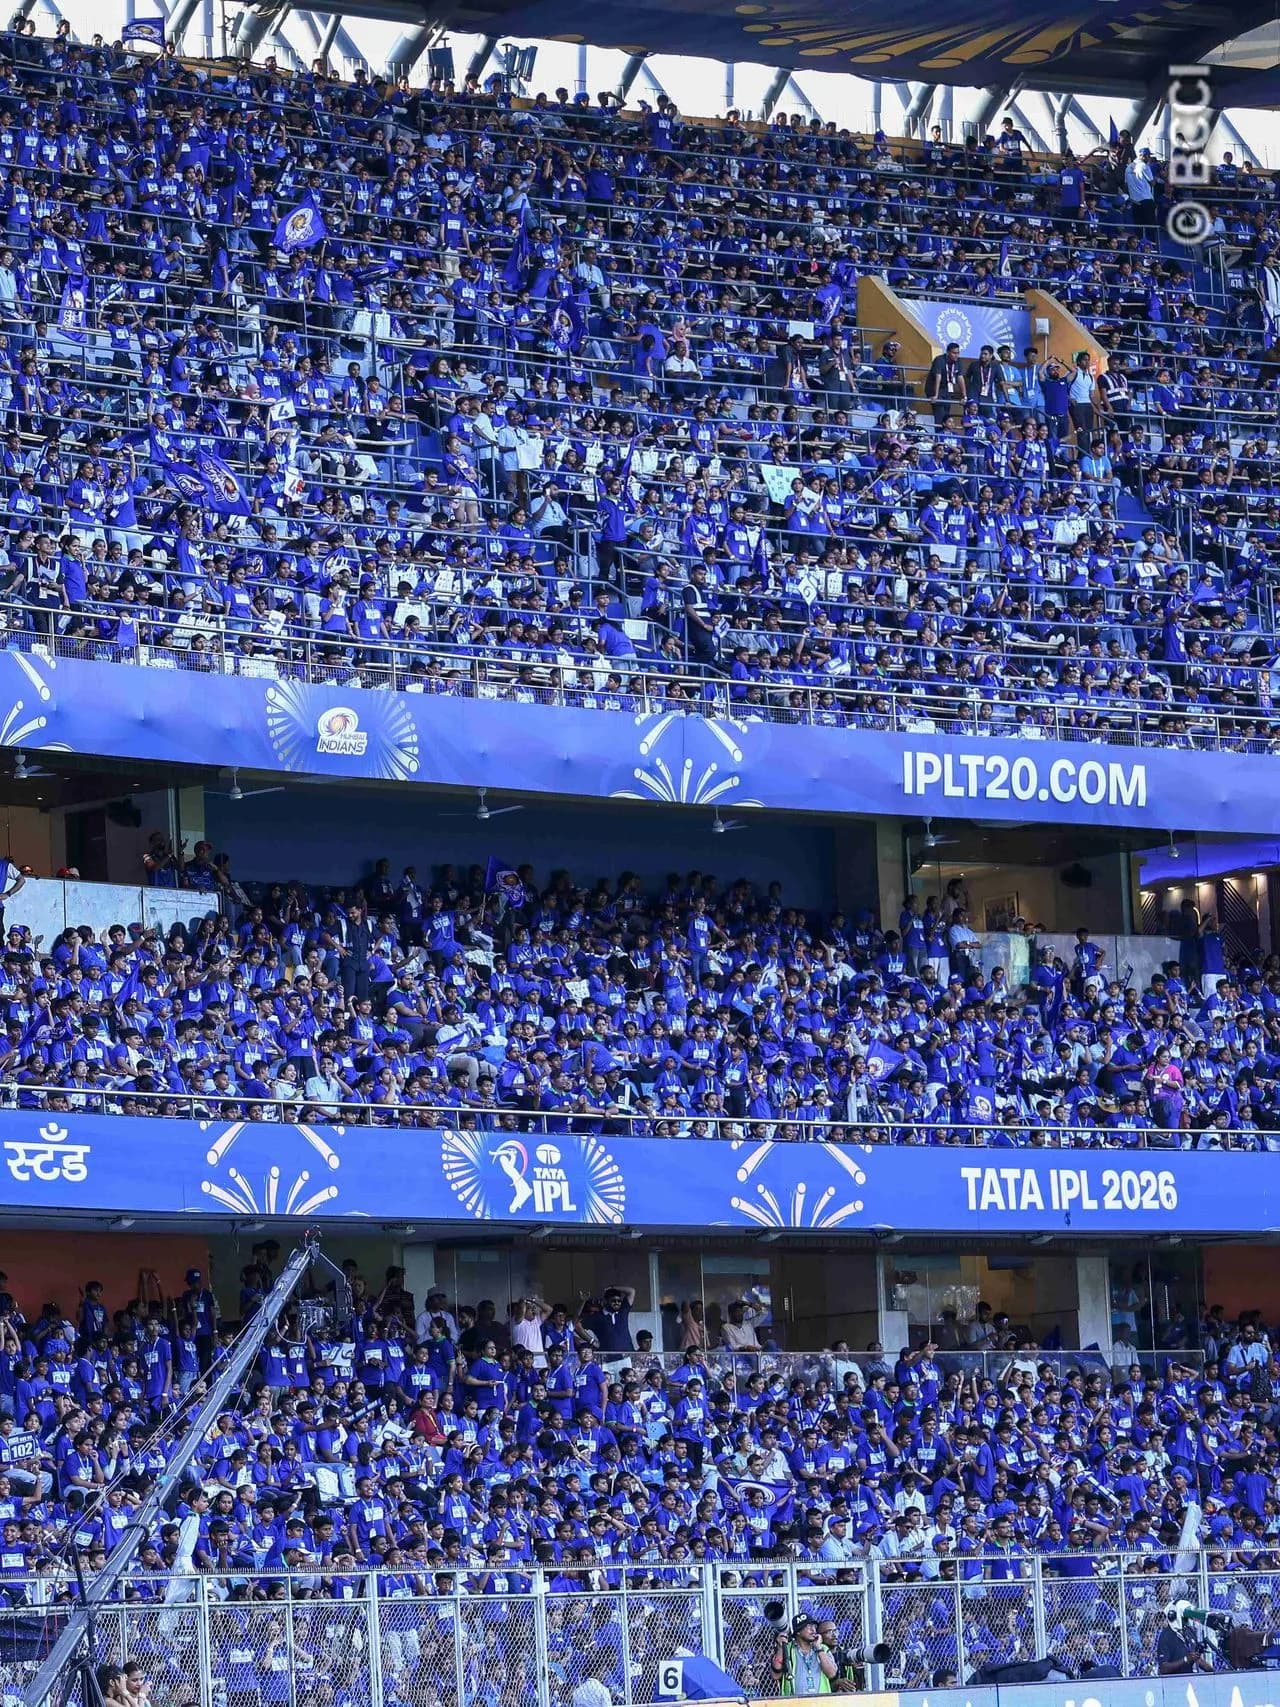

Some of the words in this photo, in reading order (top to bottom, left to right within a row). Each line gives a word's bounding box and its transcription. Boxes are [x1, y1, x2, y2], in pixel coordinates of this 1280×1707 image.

[277, 404, 290, 417] 4
[318, 738, 366, 754] INDIANS
[902, 749, 1148, 808] IPLT20.COM
[3, 1122, 91, 1182] स्टँड
[533, 1167, 567, 1180] TATA
[532, 1180, 577, 1213] IPL
[960, 1167, 1045, 1210] TATA
[1049, 1169, 1098, 1210] IPL
[1102, 1169, 1178, 1210] 2026
[10, 1441, 34, 1459] 102
[662, 1666, 680, 1690] 6
